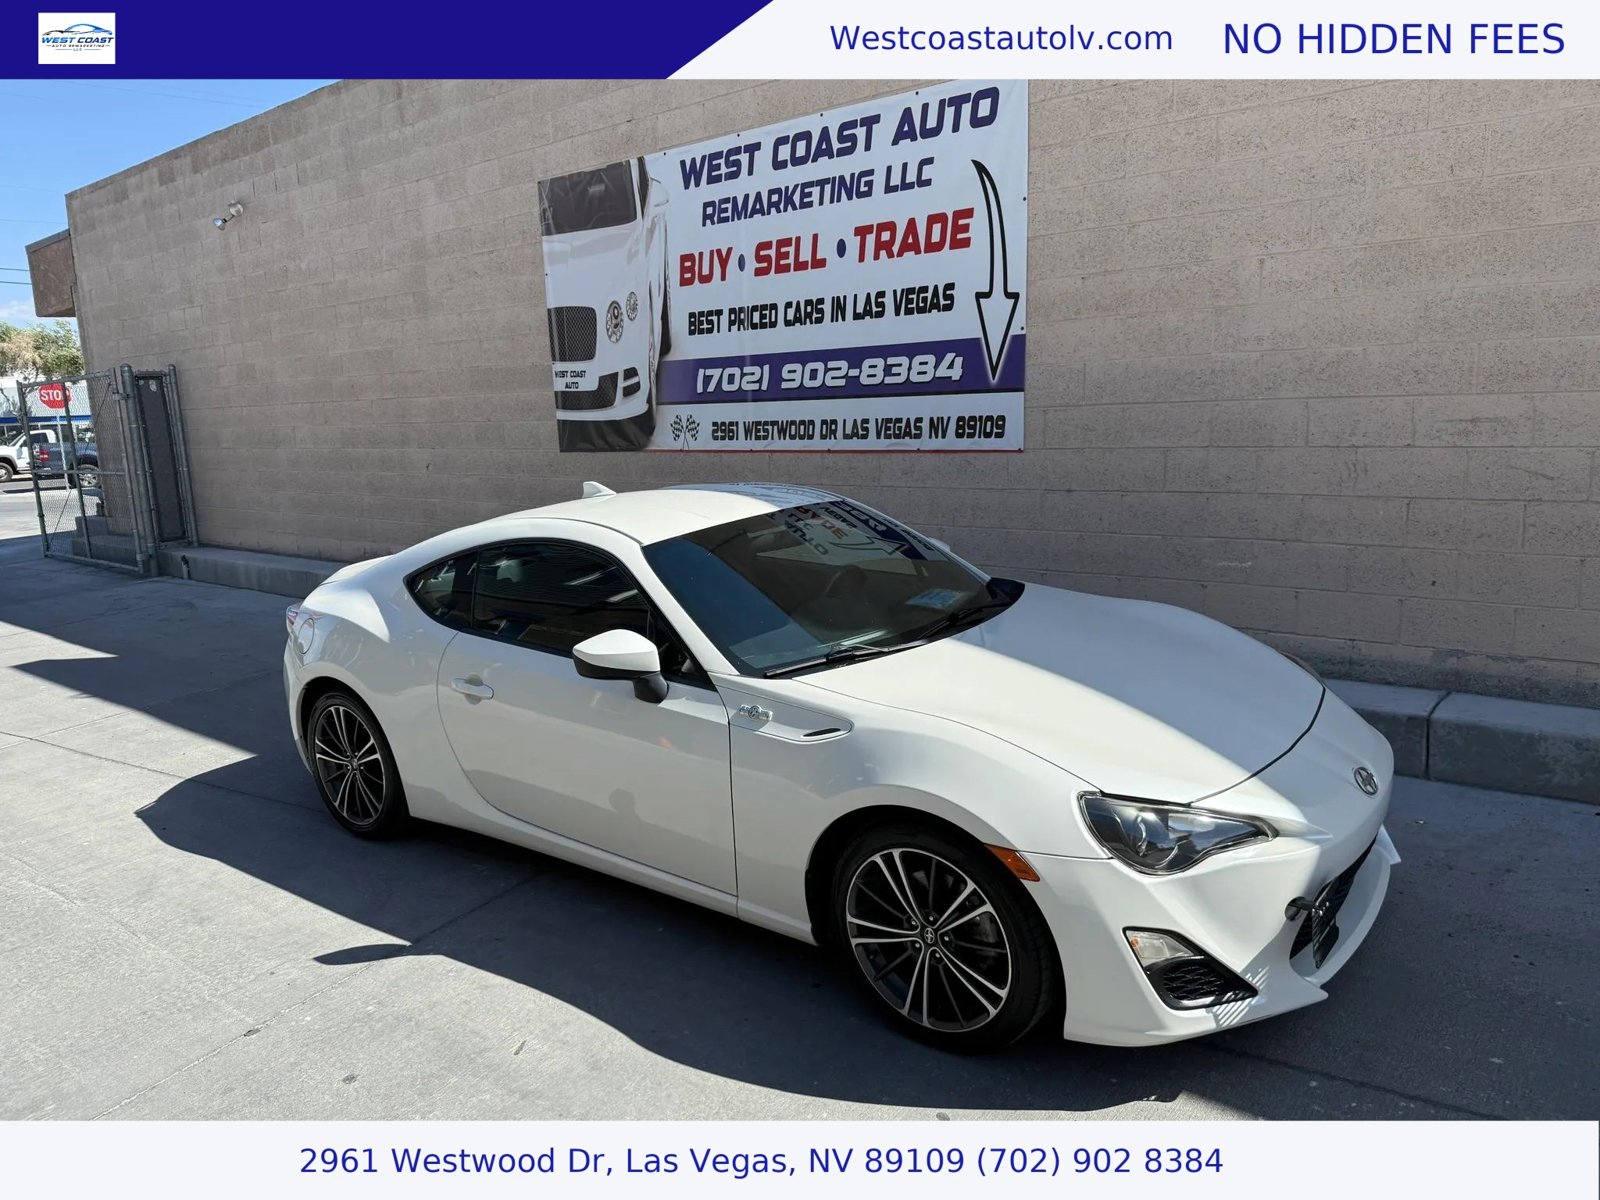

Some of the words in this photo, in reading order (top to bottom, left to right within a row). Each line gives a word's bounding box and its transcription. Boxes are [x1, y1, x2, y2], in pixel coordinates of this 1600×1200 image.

[679, 141, 762, 190] WEST
[772, 113, 881, 172] COAST
[891, 86, 1000, 146] AUTO
[701, 168, 874, 227] REMARKETING
[883, 156, 935, 195] LLC
[679, 246, 733, 287] BUY
[753, 233, 827, 277] SELL
[854, 207, 975, 263] TRADE
[688, 308, 724, 336] BEST
[728, 302, 778, 333] PRICED
[783, 297, 825, 327] CARS
[831, 295, 848, 322] IN
[853, 290, 886, 321] LAS
[892, 282, 956, 317] VEGAS
[555, 370, 569, 378] WEST
[570, 370, 586, 378] COAST
[696, 366, 770, 394] (702)
[781, 352, 964, 390] 902-8384
[711, 421, 740, 442] 2961
[743, 418, 816, 441] WESTWOOD
[820, 418, 839, 441] DR
[843, 418, 870, 440] LAS
[875, 417, 924, 440] VEGAS
[928, 416, 951, 439] NV
[955, 414, 1007, 439] 89109
